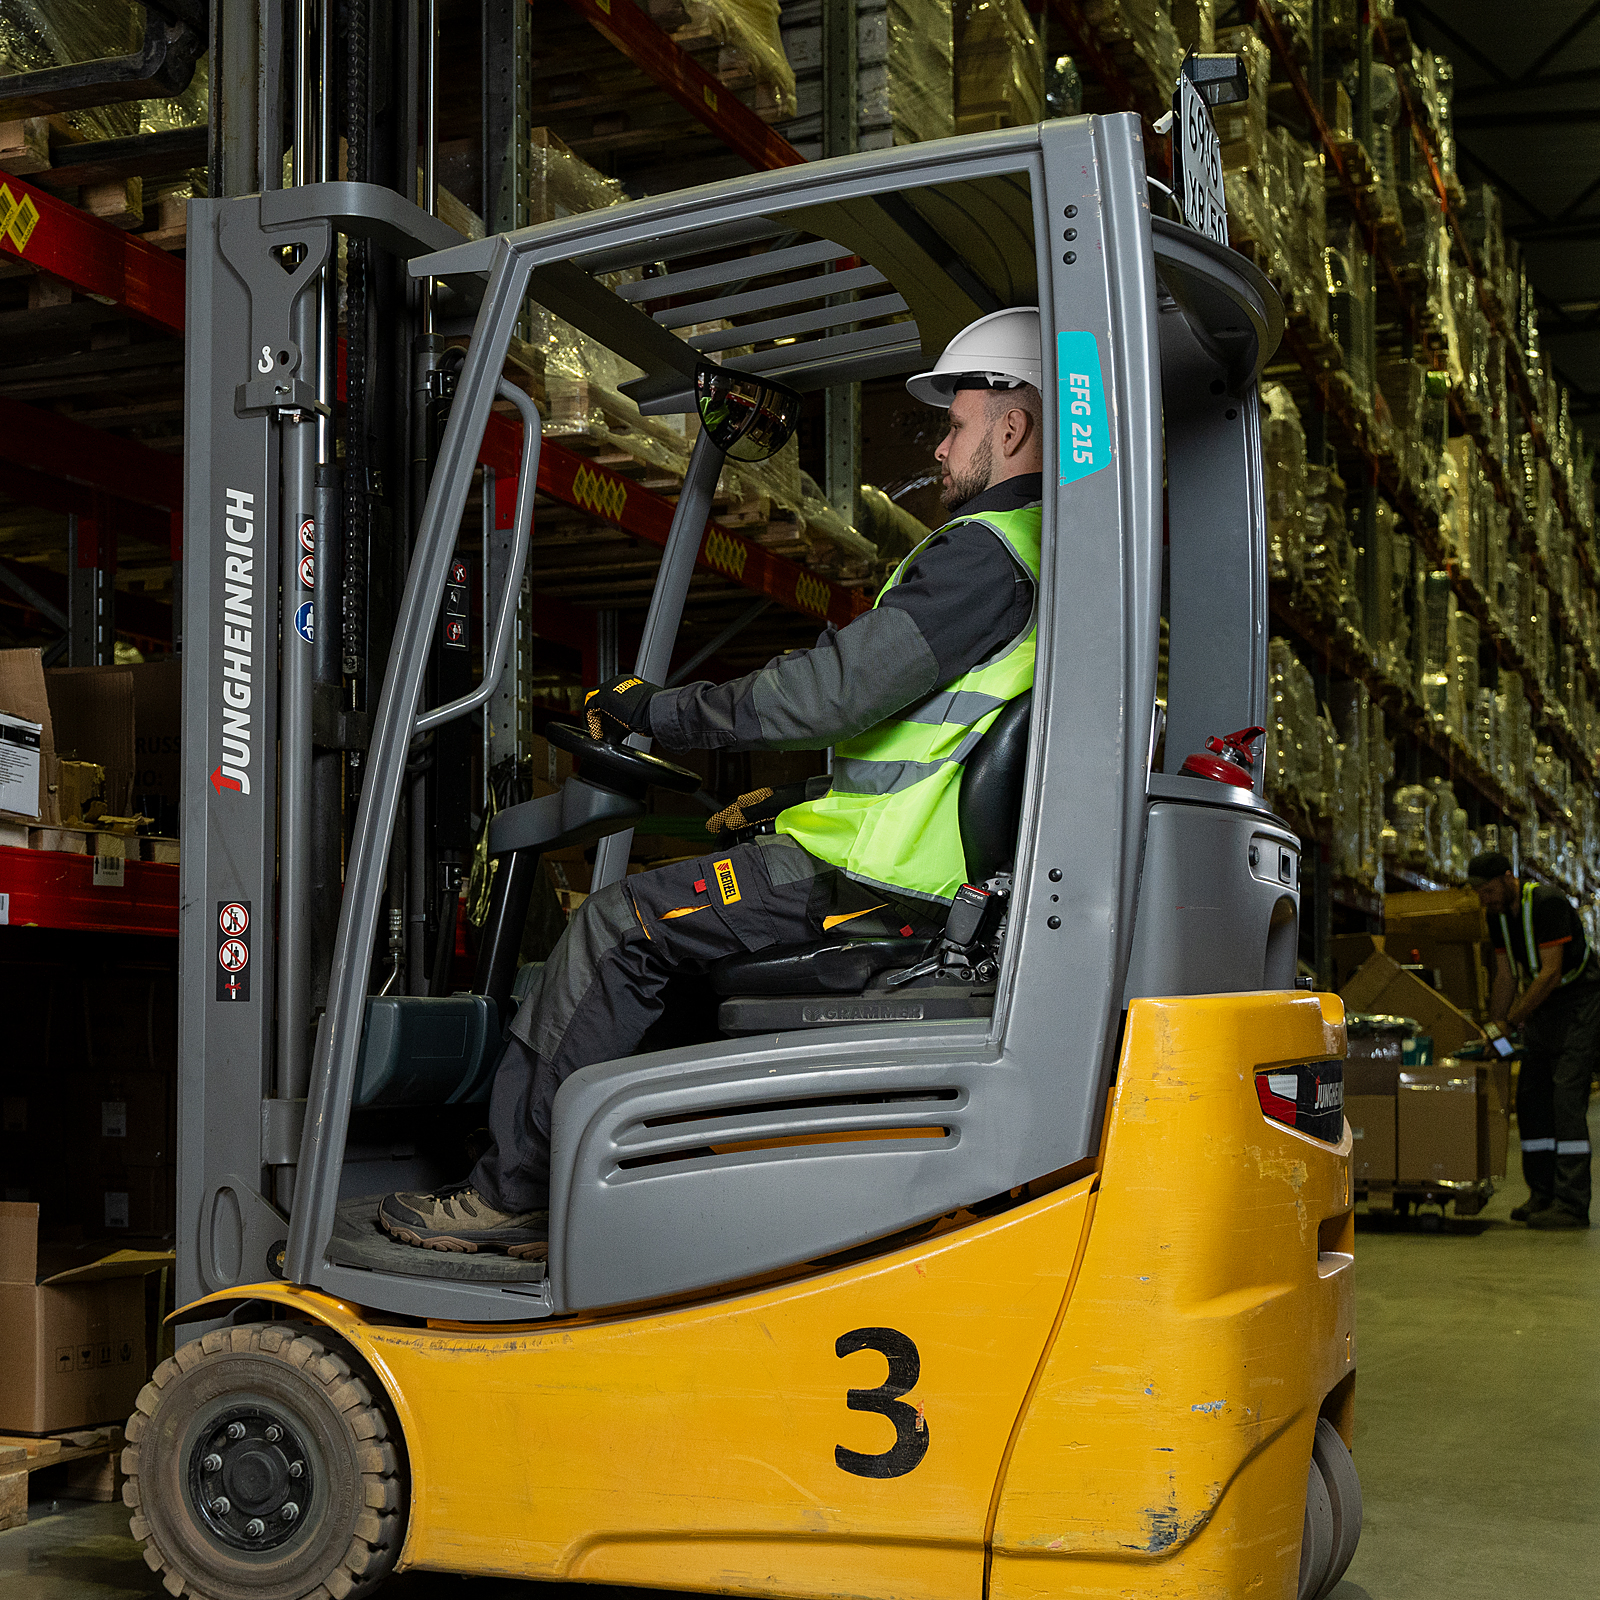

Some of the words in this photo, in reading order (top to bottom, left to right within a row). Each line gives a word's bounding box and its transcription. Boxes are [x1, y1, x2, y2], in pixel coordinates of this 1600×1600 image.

[1069, 373, 1091, 416] EFG
[1071, 422, 1094, 465] 215
[221, 487, 254, 796] JUNGHEINRICH
[719, 870, 737, 900] DENZEL
[834, 1326, 930, 1479] 3
